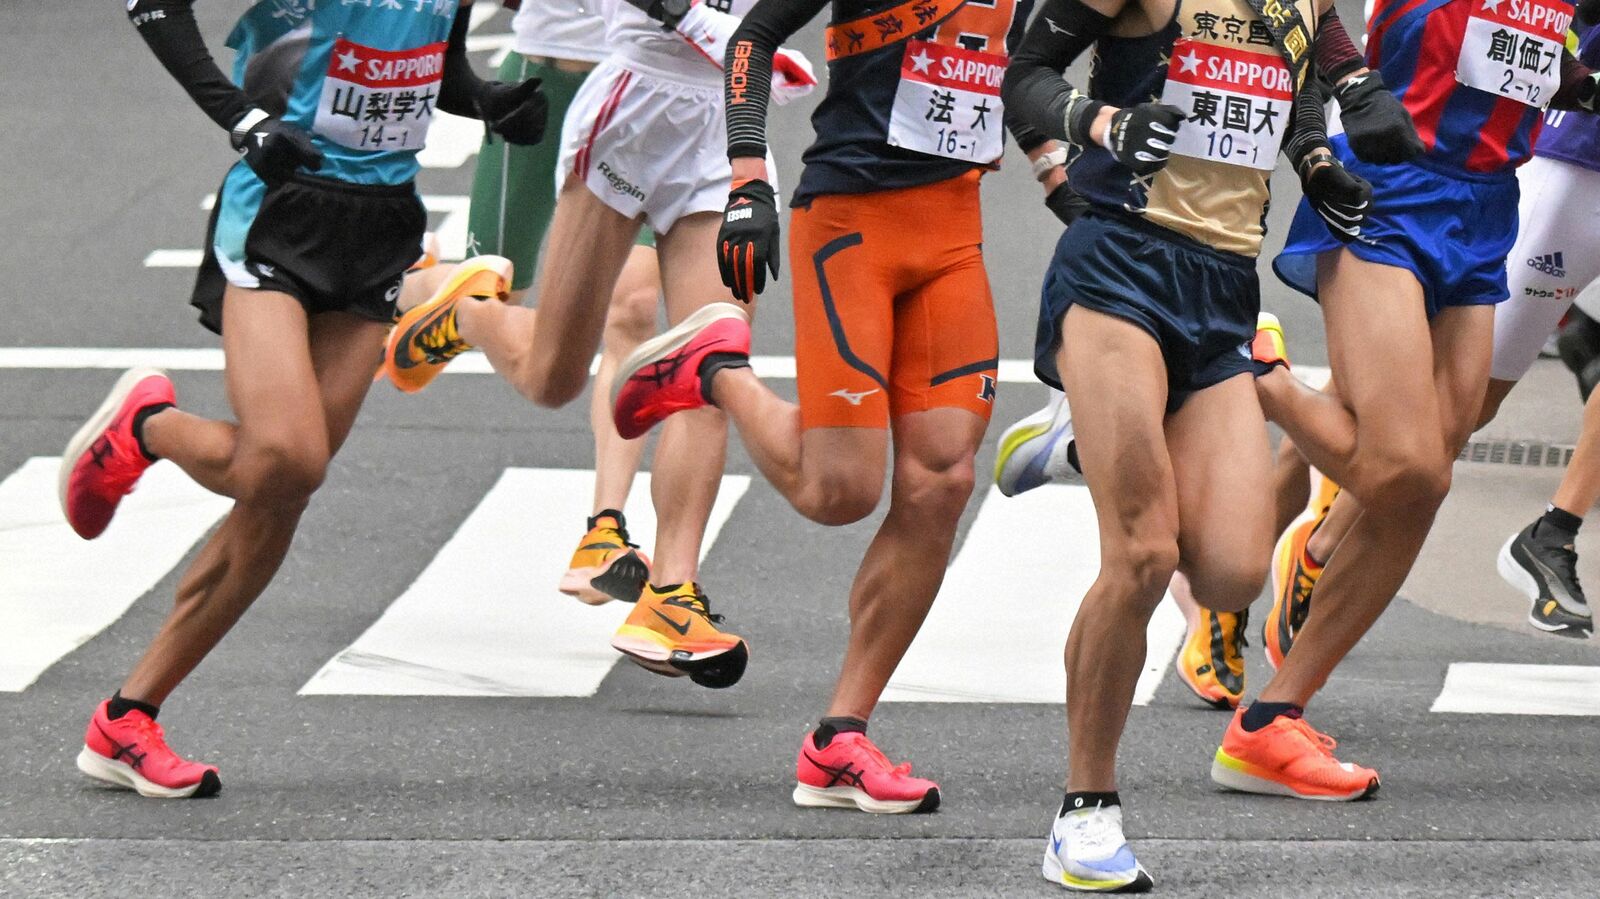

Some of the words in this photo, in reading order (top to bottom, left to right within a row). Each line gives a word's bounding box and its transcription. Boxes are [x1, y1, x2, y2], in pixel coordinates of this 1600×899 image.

[1487, 28, 1557, 77] 創価大
[730, 40, 753, 105] HOSEI
[1205, 56, 1294, 93] SAPPOR
[1500, 69, 1541, 103] 2-12
[331, 86, 436, 122] 山梨学大
[1187, 91, 1279, 136] 東国大
[360, 125, 408, 147] 14-1
[936, 128, 977, 157] 16-1
[1207, 131, 1258, 164] 10-1
[597, 161, 646, 202] Regain
[1527, 258, 1566, 278] adidas
